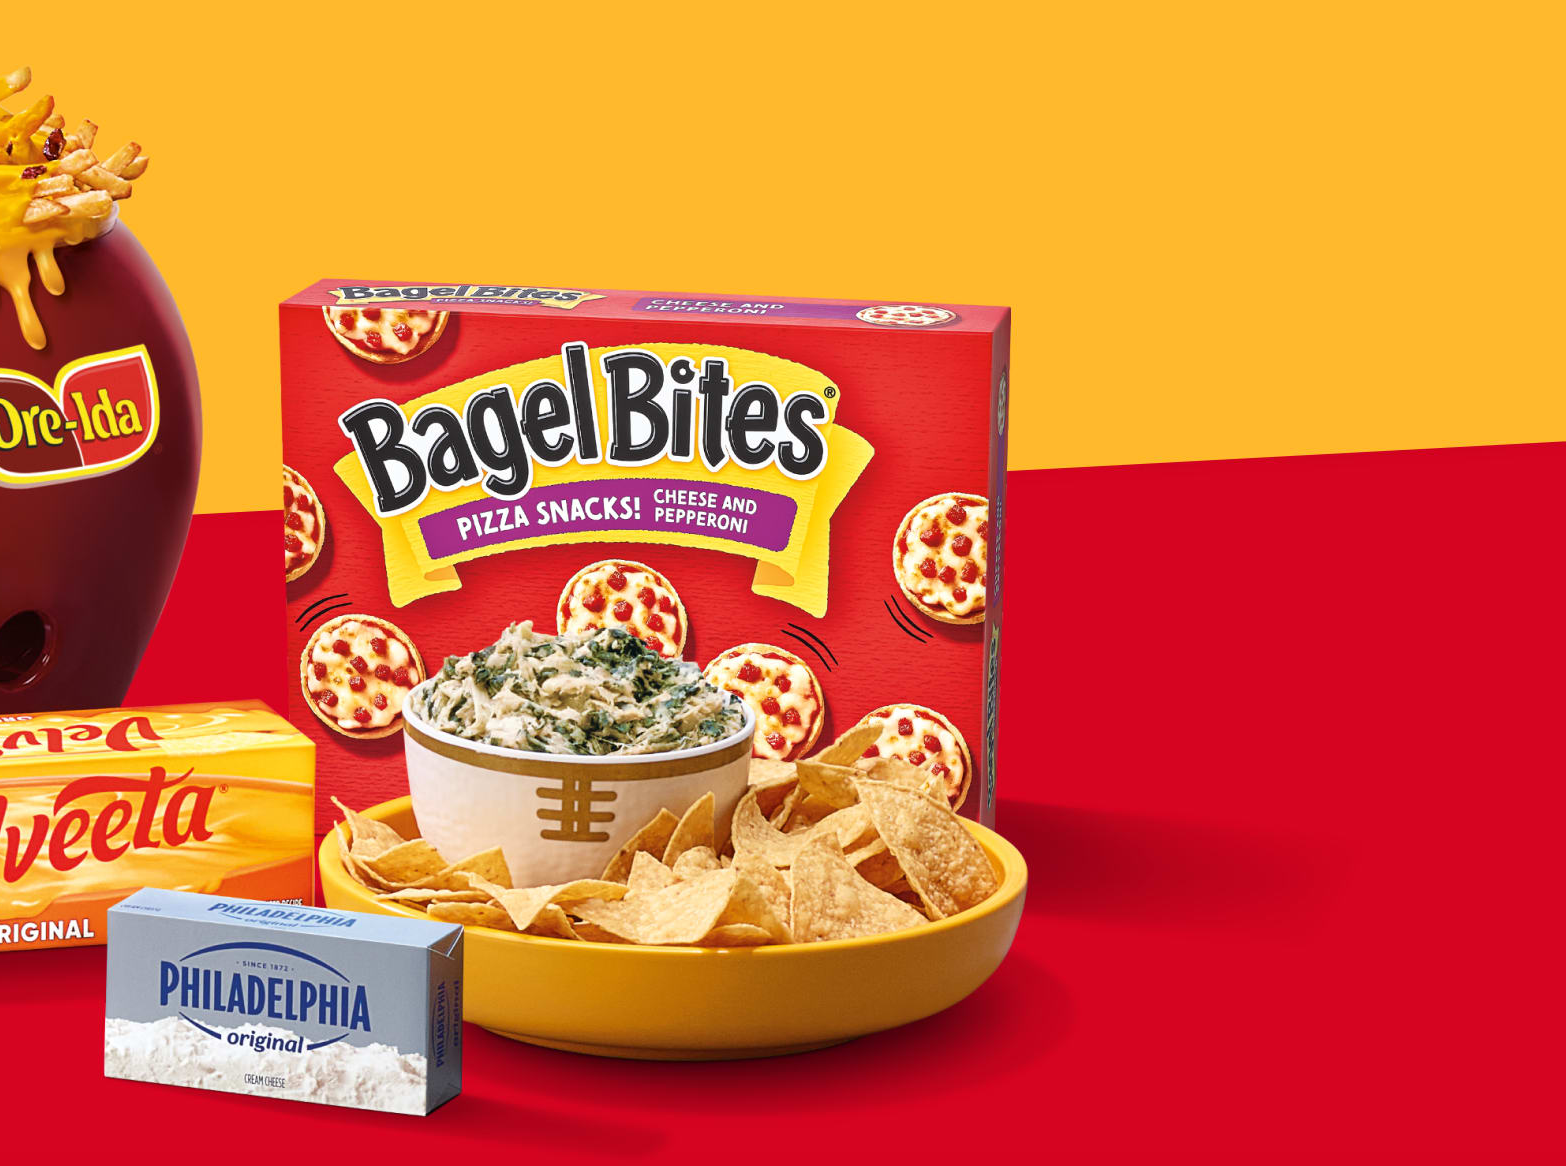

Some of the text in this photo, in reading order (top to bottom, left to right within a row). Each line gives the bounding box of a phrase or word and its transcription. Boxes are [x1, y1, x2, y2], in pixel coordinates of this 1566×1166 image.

[339, 285, 582, 302] Bagel Bites
[650, 299, 734, 308] CHEESE
[645, 305, 768, 315] PEPPERONI
[343, 345, 597, 512] Bagel
[653, 488, 757, 515] CHEESE AND
[456, 496, 641, 541] PIZZA SNACKS!
[655, 507, 748, 534] PEPPERONI
[208, 903, 357, 927] PHILADELPHIA
[242, 960, 289, 972] SINCE 1872
[159, 960, 371, 1033] PHILADELPHIA
[226, 1030, 305, 1054] original
[244, 1073, 286, 1089] CREAM CHEESE
